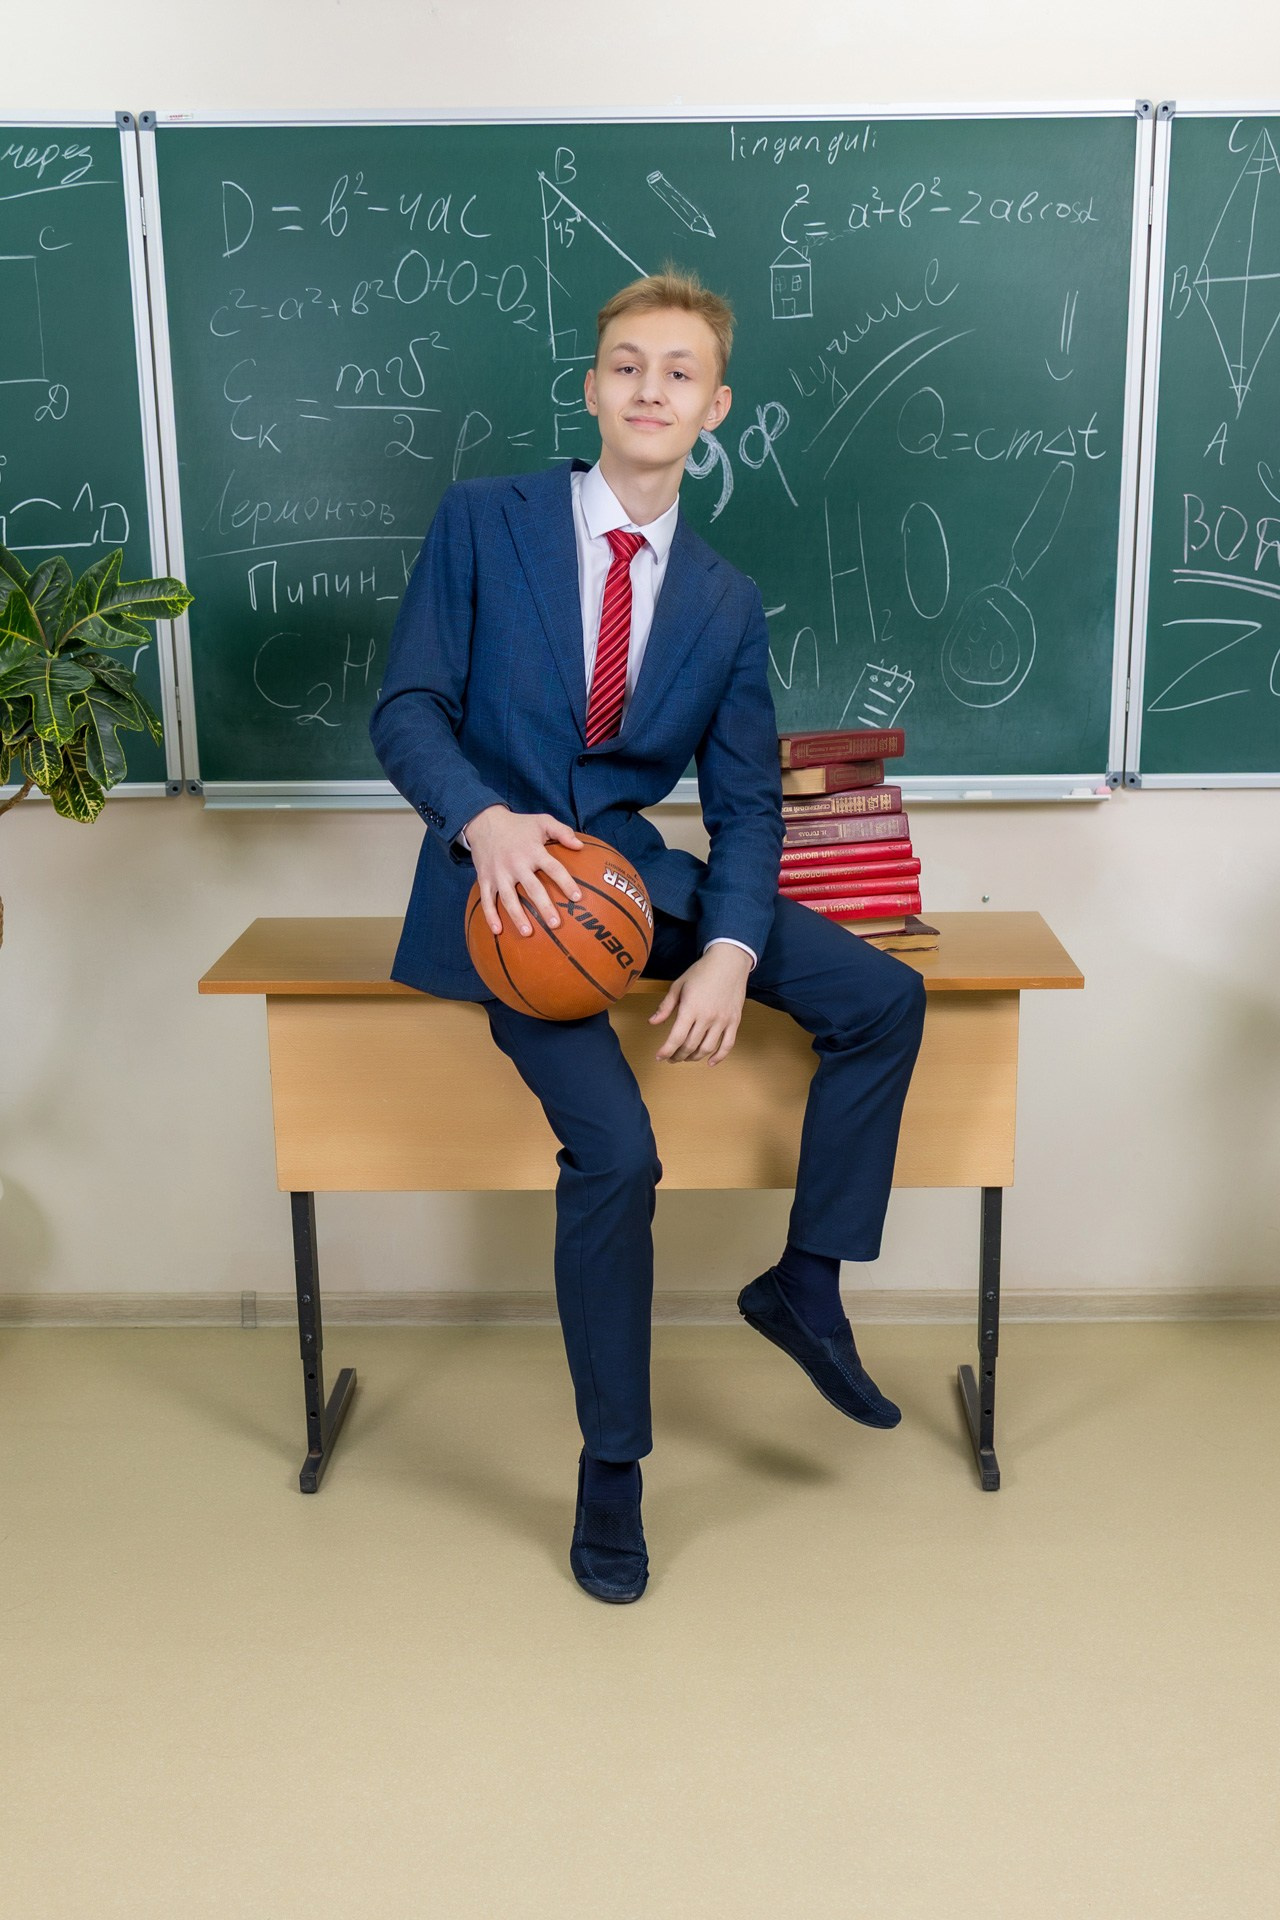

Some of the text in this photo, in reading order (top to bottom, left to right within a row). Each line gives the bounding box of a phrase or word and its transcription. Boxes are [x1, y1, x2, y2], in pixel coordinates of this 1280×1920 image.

[554, 147, 577, 184] B
[222, 181, 254, 258] D
[556, 900, 634, 970] DEMIX
